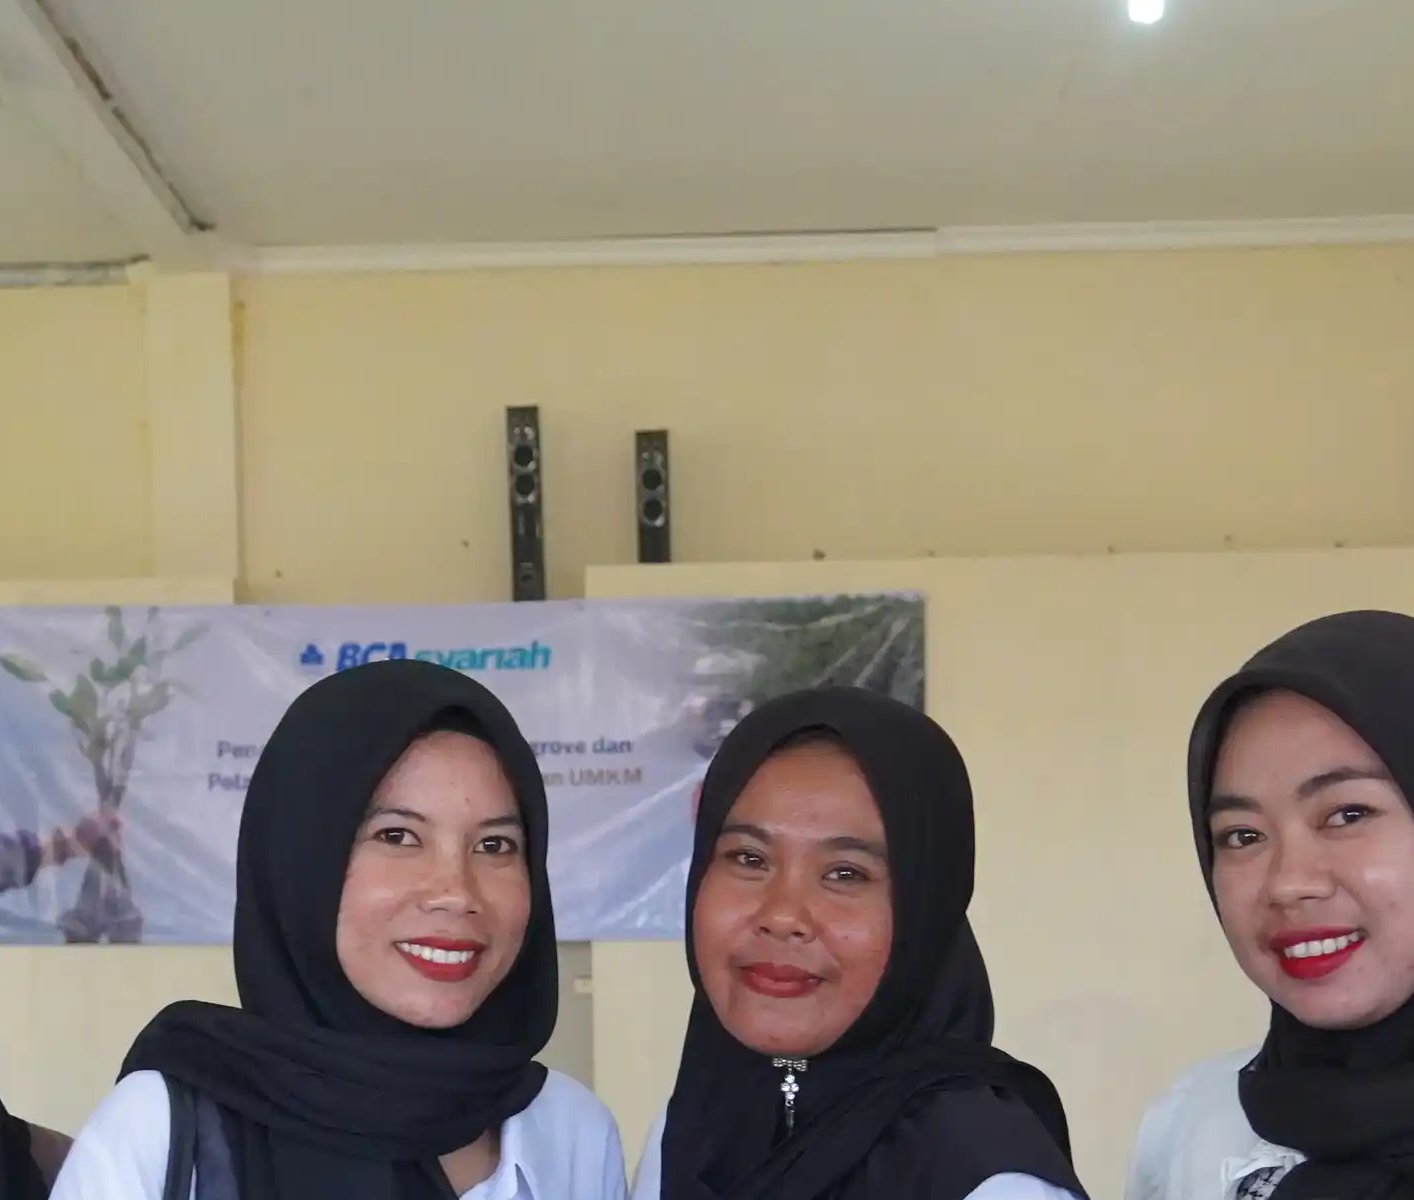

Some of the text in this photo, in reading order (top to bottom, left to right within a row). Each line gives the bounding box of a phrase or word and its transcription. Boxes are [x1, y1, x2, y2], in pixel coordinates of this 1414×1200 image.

[335, 641, 408, 671] BCA
[592, 735, 633, 755] dan
[569, 767, 643, 786] UMKM
